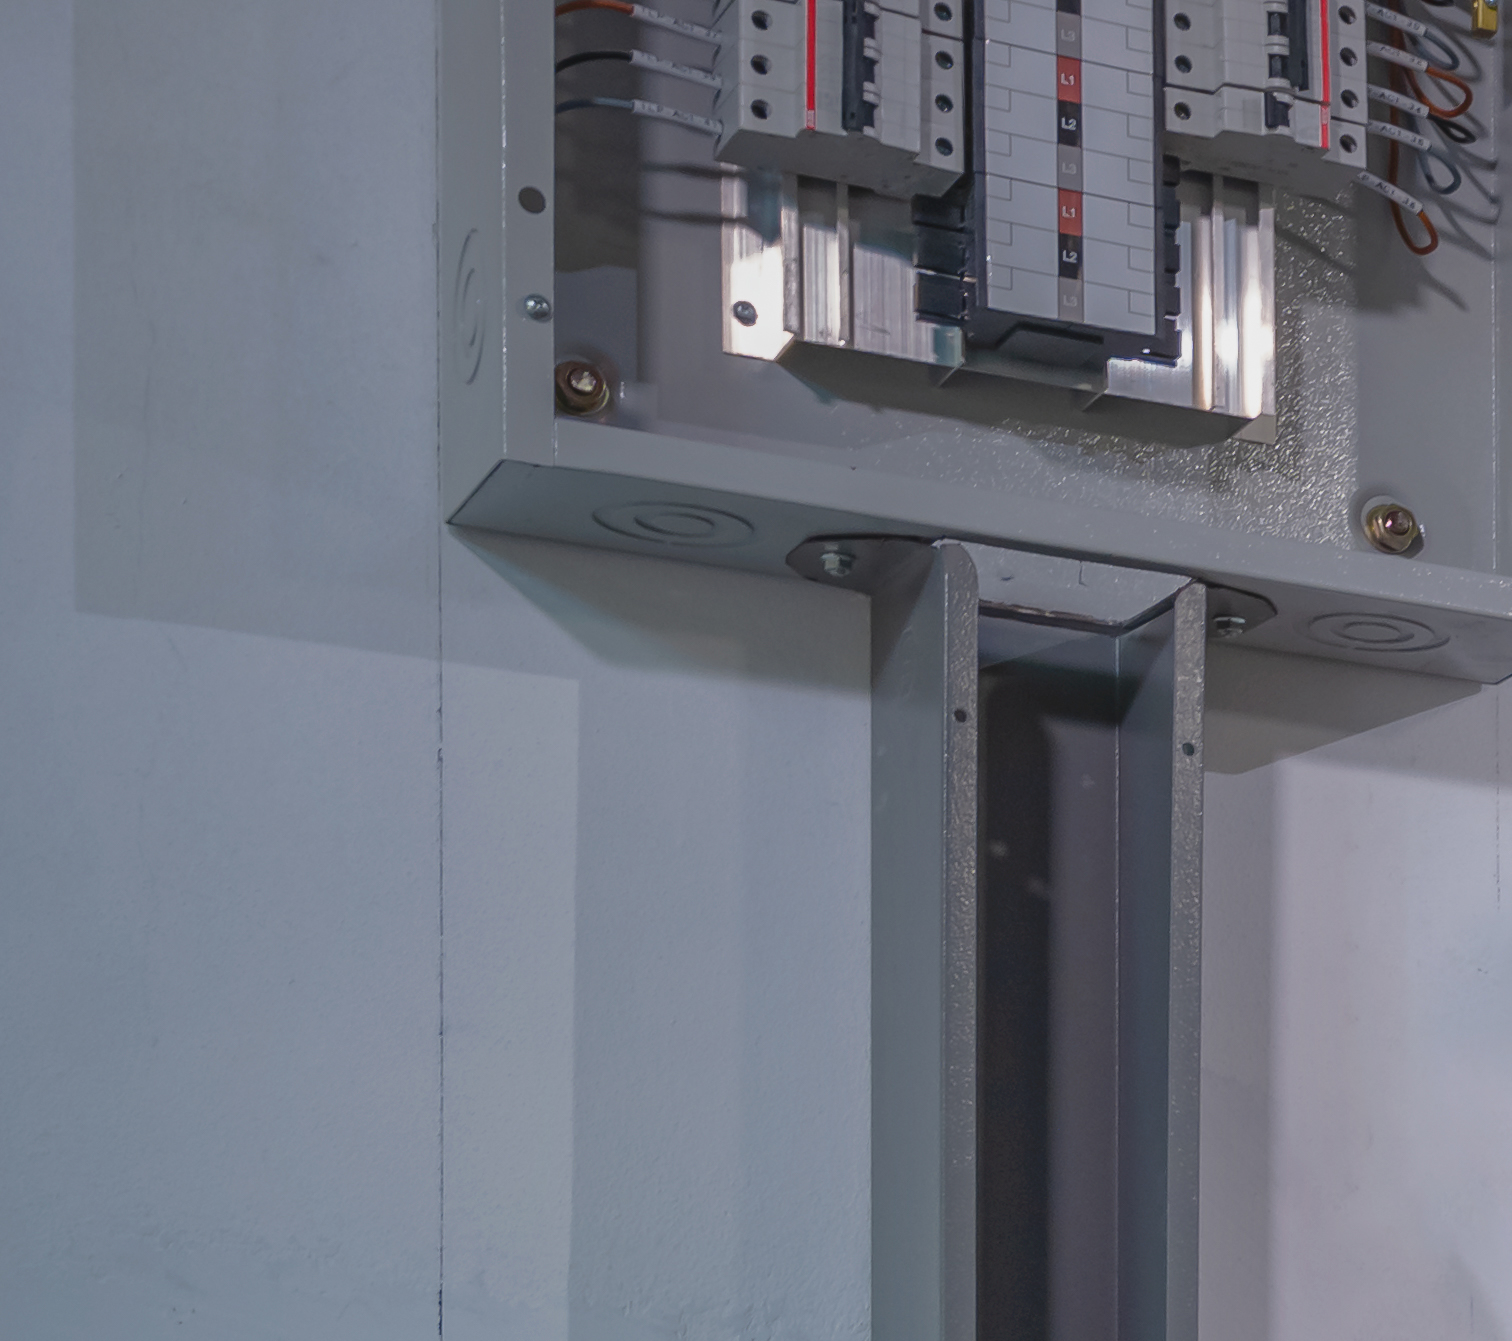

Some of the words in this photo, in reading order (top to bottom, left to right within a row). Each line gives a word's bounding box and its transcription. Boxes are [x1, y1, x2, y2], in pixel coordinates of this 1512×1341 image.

[1060, 29, 1076, 42] L3
[1060, 72, 1075, 86] L1
[1061, 116, 1077, 131] L2
[1061, 162, 1077, 175] L3
[1061, 205, 1076, 218] L1
[1062, 249, 1078, 263] L2
[1063, 294, 1078, 307] L3
